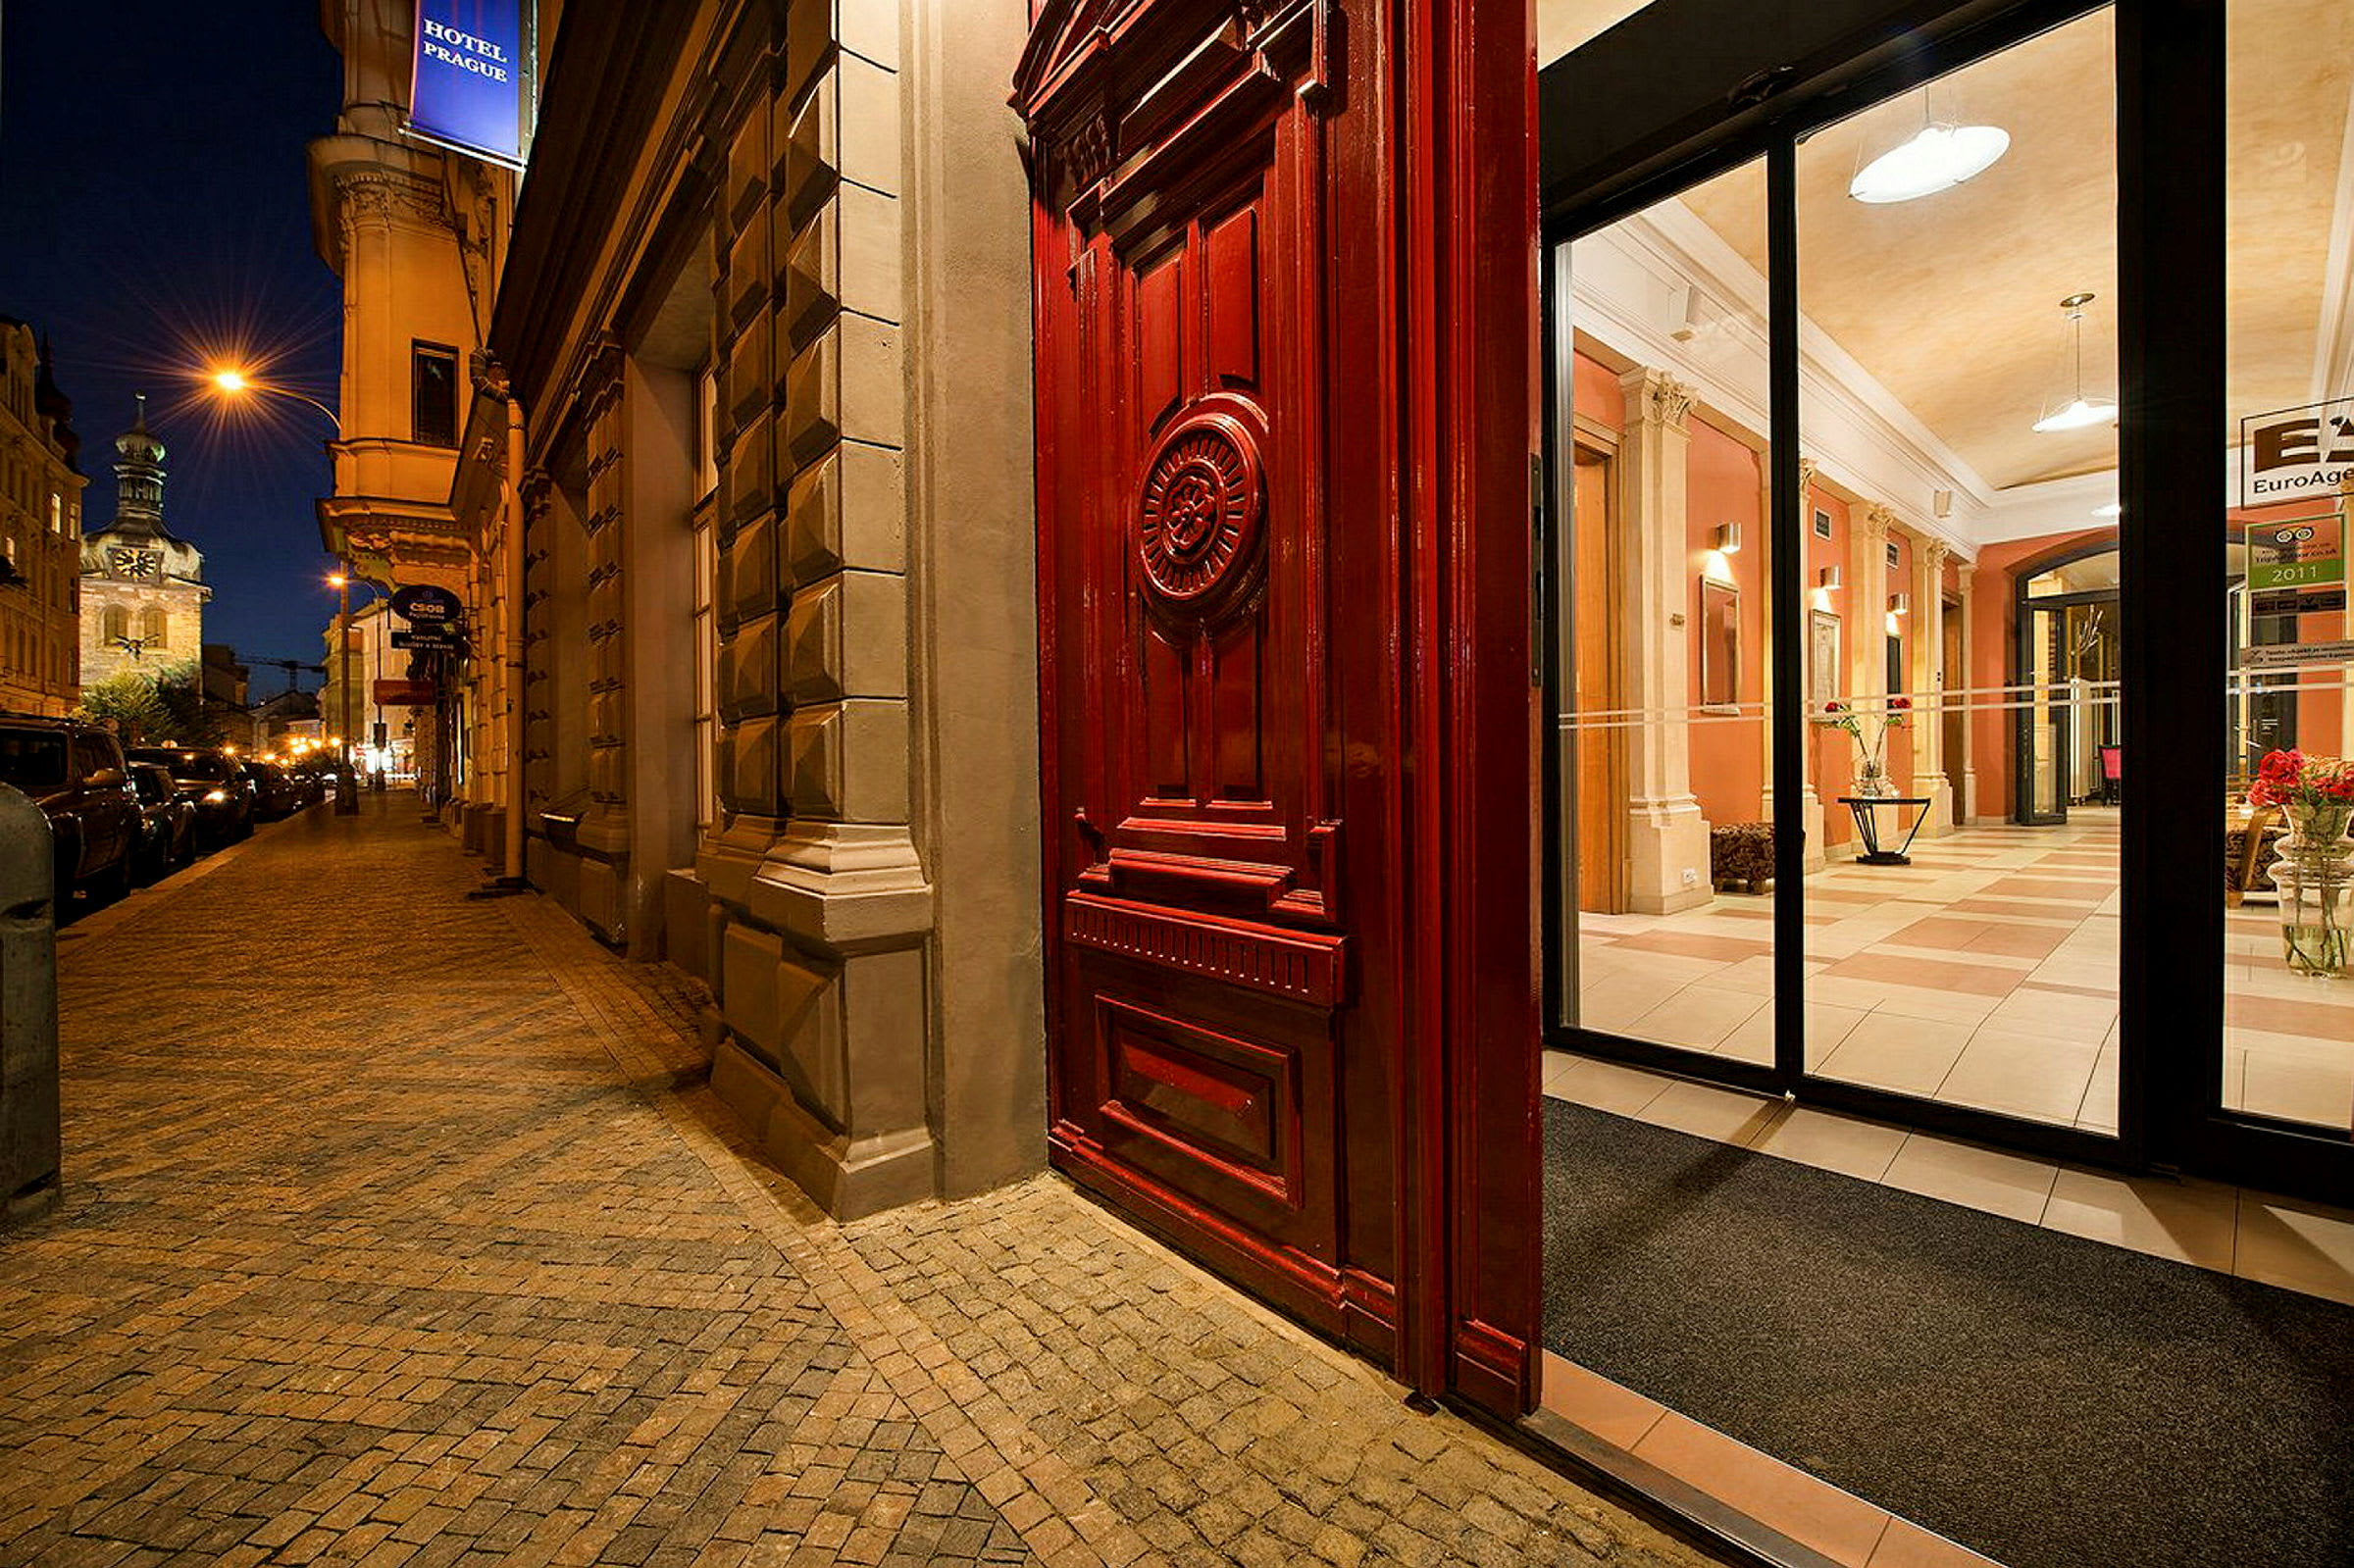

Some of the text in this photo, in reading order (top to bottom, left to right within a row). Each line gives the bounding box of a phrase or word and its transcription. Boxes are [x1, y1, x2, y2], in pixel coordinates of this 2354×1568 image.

[424, 19, 508, 63] HOTEL
[424, 41, 508, 82] PRAGUE
[2272, 565, 2317, 582] 2011
